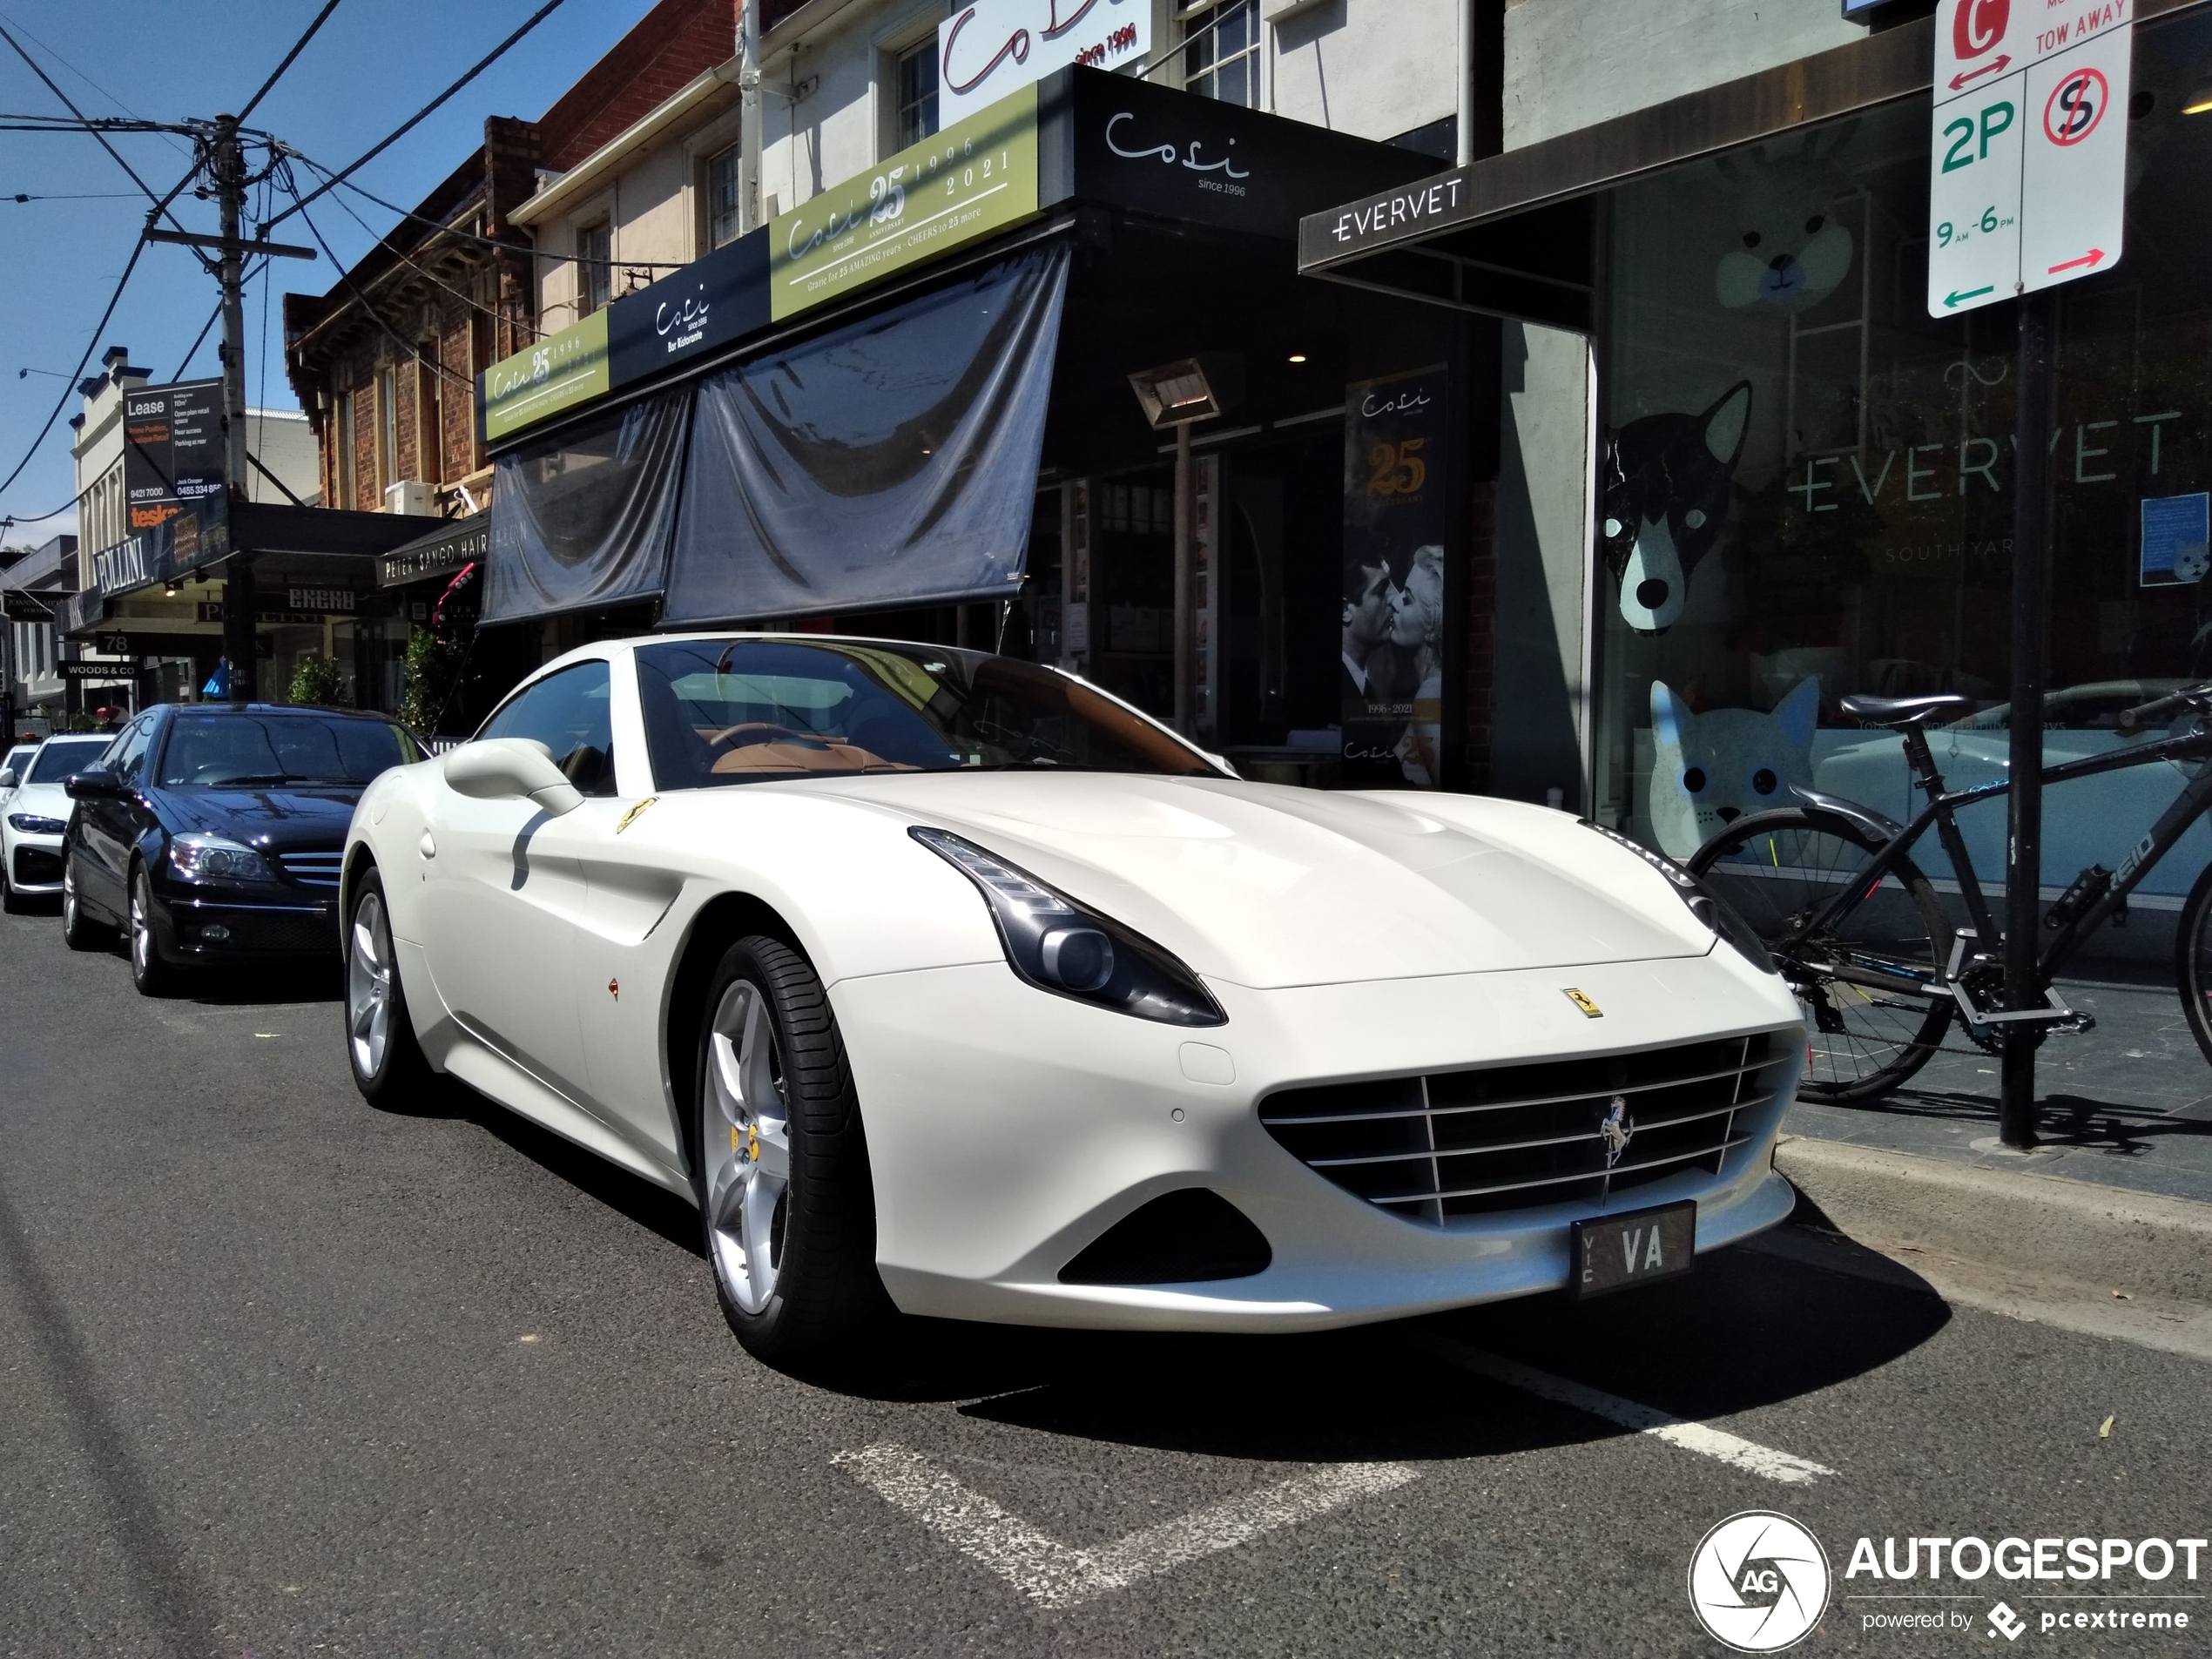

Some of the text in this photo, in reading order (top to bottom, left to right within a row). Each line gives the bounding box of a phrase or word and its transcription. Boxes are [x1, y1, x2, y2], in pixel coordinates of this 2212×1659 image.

[1075, 22, 1136, 65] since 1996
[2036, 0, 2125, 54] TOW AWAY
[1106, 112, 1250, 179] Cosi
[1942, 101, 2014, 174] 2P
[915, 137, 973, 181] 1996
[947, 151, 1008, 196] 2021
[1197, 177, 1246, 198] since 1996
[868, 217, 905, 239] ANNIVERSARY
[1332, 179, 1462, 242] EVERVET
[789, 199, 863, 260] Cosi
[833, 236, 854, 253] since 1996
[807, 277, 827, 292] Grazie
[828, 269, 839, 282] for
[839, 266, 849, 279] 25
[848, 250, 881, 273] AMAZING
[881, 243, 901, 263] years
[907, 226, 938, 247] CHEERS
[939, 222, 947, 233] to
[948, 215, 959, 229] 25
[960, 207, 981, 225] more
[656, 283, 710, 335] Cosi
[553, 335, 580, 359] 1996
[667, 330, 703, 353] Bar Ristorante
[494, 364, 530, 399] Cosi
[128, 401, 165, 416] Lease
[1361, 387, 1431, 418] Cosi
[153, 433, 169, 442] Retail
[1365, 436, 1426, 496] 25
[130, 488, 164, 498] 9421 7000
[177, 486, 194, 496] 0455
[195, 484, 208, 495] 334
[97, 536, 146, 594] POLLINI
[386, 556, 413, 579] PETER
[419, 544, 455, 571] SANGO
[461, 534, 487, 556] HAIR
[1886, 538, 2014, 563] SOUTH YAR
[104, 636, 128, 651] 78
[68, 665, 135, 675] WOODS & CO
[1368, 704, 1386, 714] 1996
[1393, 704, 1413, 714] 2021
[1344, 741, 1395, 759] Cosi
[1582, 1236, 1594, 1284] VIC
[1622, 1224, 1662, 1274] VA
